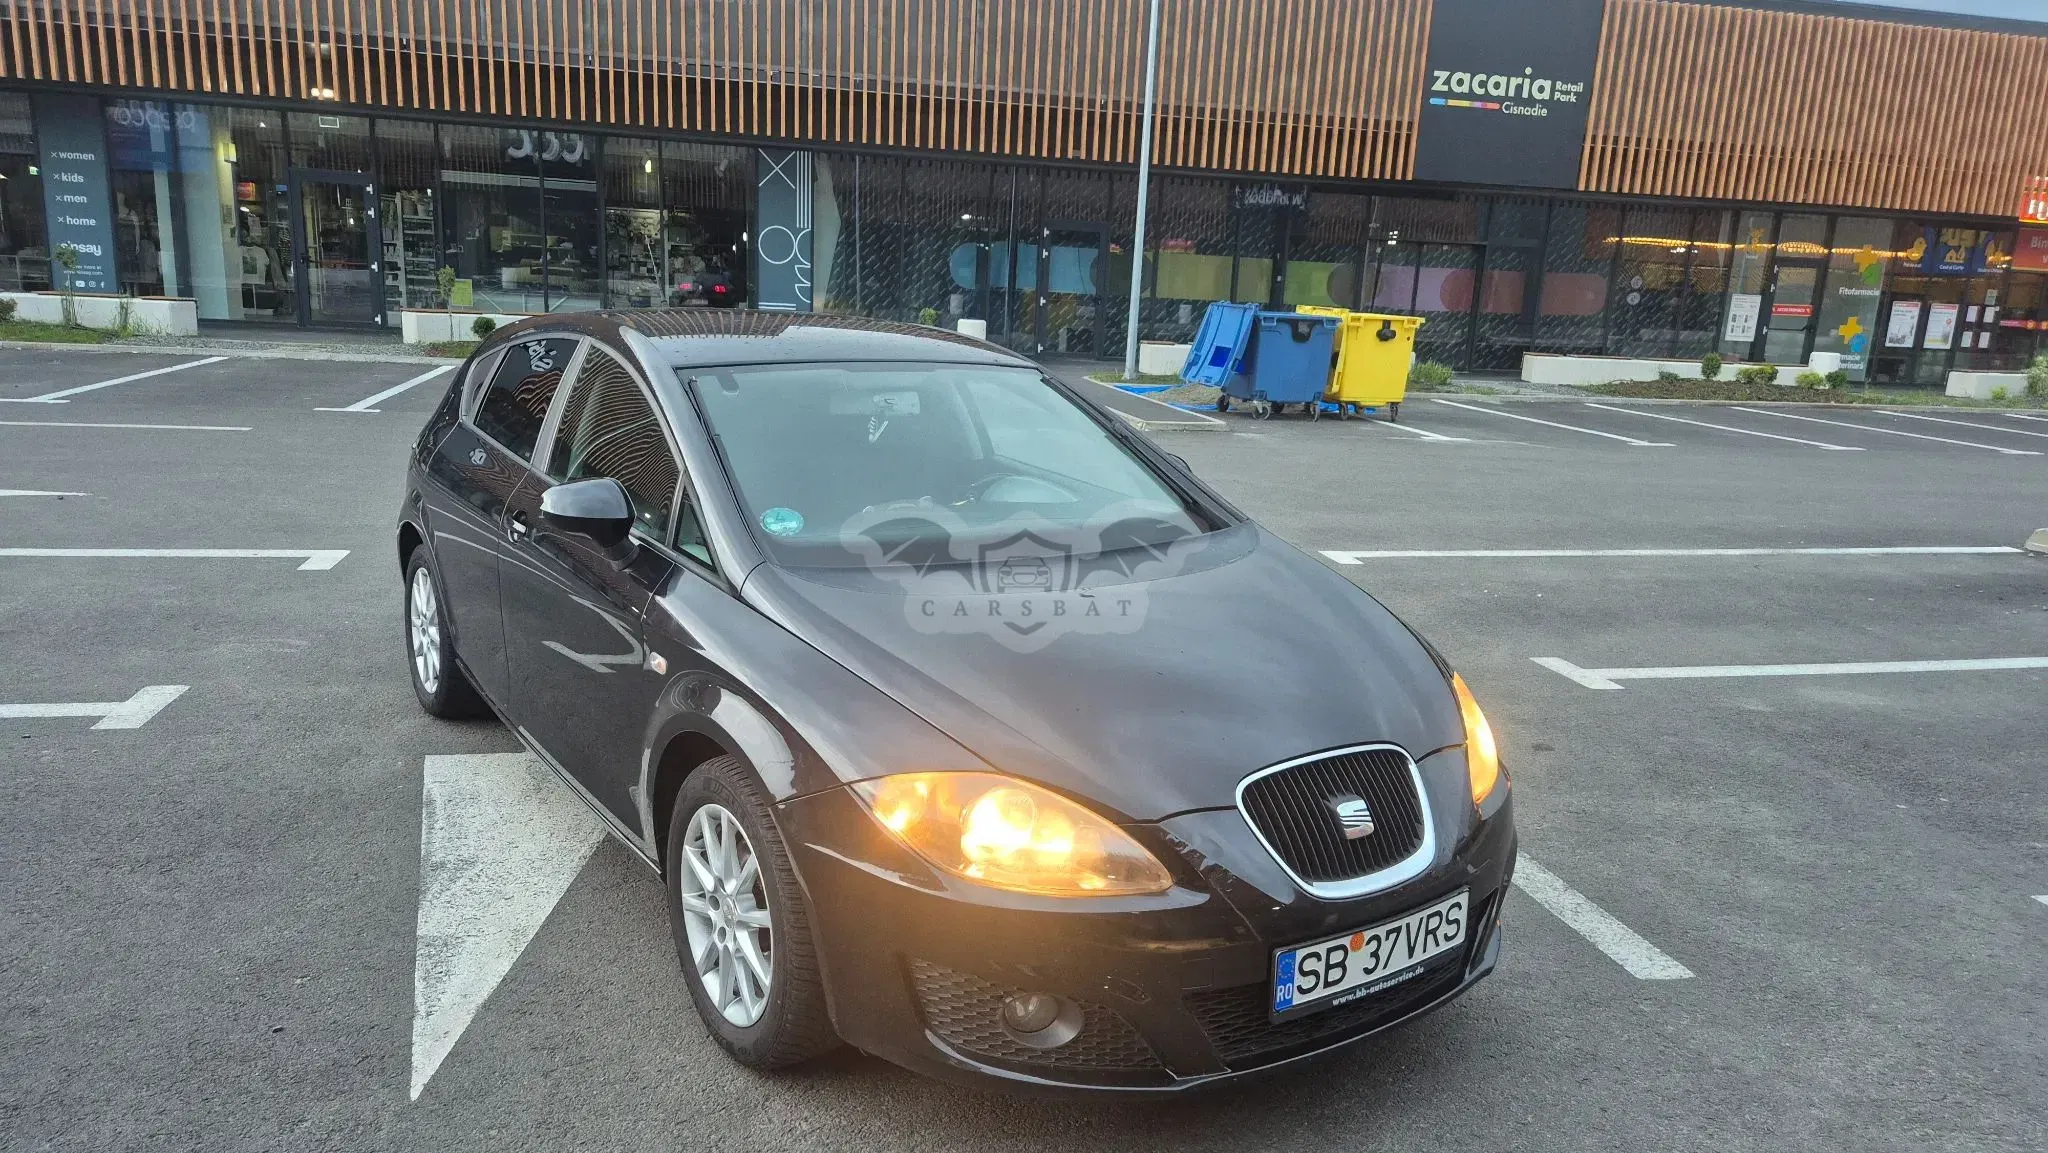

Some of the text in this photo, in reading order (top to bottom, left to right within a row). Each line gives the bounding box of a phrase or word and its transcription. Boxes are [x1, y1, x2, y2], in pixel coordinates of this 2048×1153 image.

[1431, 67, 1552, 100] zacaria
[1555, 80, 1584, 93] Retail
[1553, 91, 1577, 103] Park
[1502, 101, 1548, 117] Cisnadie
[58, 151, 95, 161] women
[61, 172, 85, 183] kids
[63, 194, 88, 203] men
[66, 215, 96, 226] home
[1841, 353, 1861, 361] macie
[1296, 943, 1349, 995] SB
[1276, 982, 1292, 1003] RO
